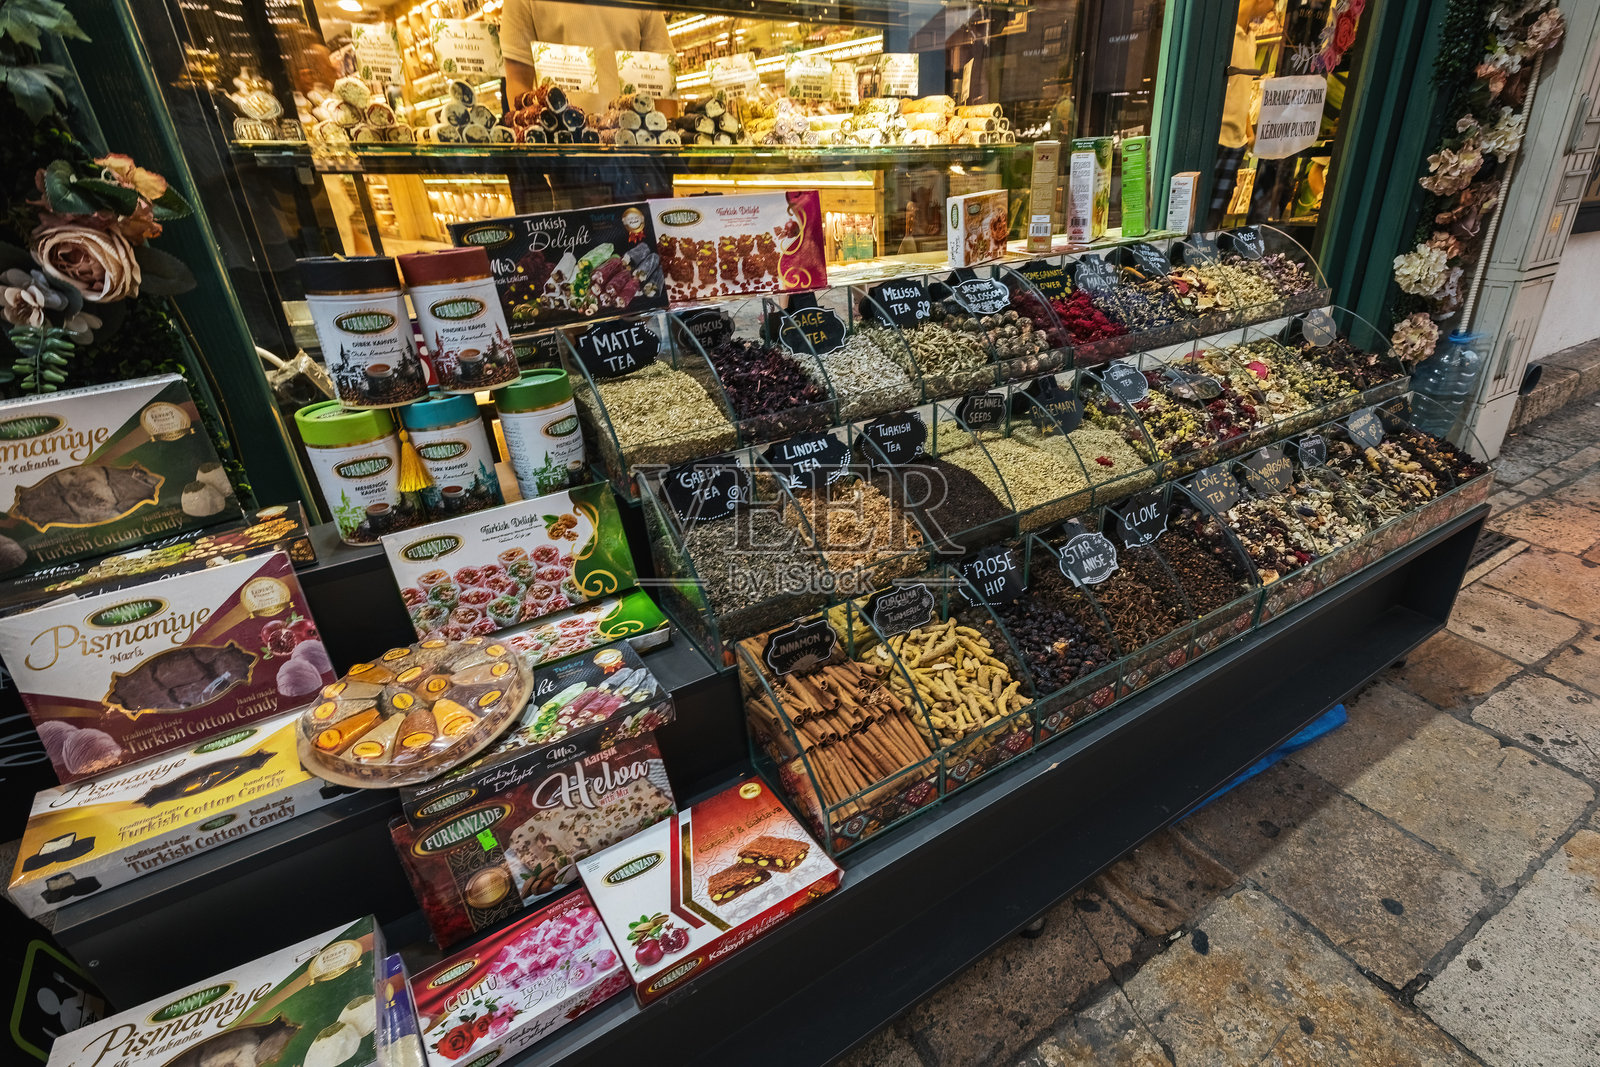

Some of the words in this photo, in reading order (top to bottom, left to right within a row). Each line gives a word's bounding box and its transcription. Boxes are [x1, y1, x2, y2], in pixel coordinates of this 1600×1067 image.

[1264, 89, 1291, 106] BARAME
[1292, 88, 1324, 105] RABOTNIK
[1291, 121, 1316, 138] PUNTOR
[523, 216, 567, 232] Turkish
[468, 230, 509, 244] FURKANZADE
[527, 225, 592, 256] Delight
[1238, 232, 1255, 242] ROSE
[490, 257, 516, 275] Mix
[1081, 263, 1106, 276] BLUE
[961, 282, 994, 295] JASMINE
[966, 288, 1004, 303] BLOSSOM
[435, 301, 483, 317] FURKANZADE
[889, 303, 911, 316] TEA
[341, 314, 394, 332] FURKANZADE
[784, 312, 825, 335] SAGE
[592, 327, 643, 356] MATE
[805, 331, 828, 346] TEA
[603, 352, 636, 372] TEA
[1120, 379, 1133, 388] TEA
[974, 398, 1002, 409] FENNEL
[1031, 400, 1077, 419] ROSEMARY
[967, 411, 992, 424] SEEDS
[875, 422, 911, 437] TURKISH
[420, 444, 465, 457] FURKANZADE
[783, 438, 829, 460] LINDEN
[882, 440, 901, 454] TEA
[8, 457, 60, 475] Kakaolu
[341, 457, 389, 476] FURKANZADE
[793, 454, 822, 474] TEA
[678, 466, 722, 489] GREEN
[1195, 472, 1220, 493] LOVE
[1263, 477, 1281, 490] TEA
[692, 486, 721, 503] TEA
[1207, 491, 1226, 505] TEA
[480, 521, 510, 535] Turkish
[511, 513, 539, 528] Delight
[1124, 502, 1161, 531] CLOVE
[35, 534, 94, 562] Turkish
[93, 526, 142, 548] Cotton
[143, 516, 184, 537] Candy
[407, 538, 458, 558] FURKANZADE
[972, 549, 1017, 577] ROSE
[1063, 544, 1092, 566] STAR
[1081, 551, 1107, 573] ANISE
[983, 576, 1007, 597] HIP
[879, 589, 918, 610] CURCUMA
[885, 604, 922, 623] TURMERIC
[24, 606, 211, 671] Pişmaniye
[771, 633, 821, 658] CINNAMON
[553, 660, 585, 674] Turkey
[127, 728, 186, 756] Turkish
[187, 709, 236, 735] Cotton
[236, 695, 279, 719] Candy
[545, 744, 577, 760] Mix
[477, 765, 518, 785] Turkish
[493, 762, 541, 793] Delight
[532, 761, 649, 809] Helva
[422, 790, 471, 816] FURKANZADE
[616, 787, 629, 799] Mix
[118, 816, 182, 843] Turkish
[185, 794, 236, 820] Cotton
[238, 776, 285, 799] Candy
[424, 807, 502, 851] FURKANZADE
[127, 844, 196, 875] Turkish
[196, 823, 248, 850] Cotton
[249, 804, 296, 829] Candy
[610, 854, 660, 882] FURKANZADE
[708, 938, 745, 961] Kadayıf
[653, 959, 699, 989] FURKANZADE
[443, 973, 500, 1014] GÜLLÜ
[520, 973, 558, 997] Turkish
[82, 982, 273, 1067] Pişmaniye
[504, 1020, 541, 1045] Turkish
[519, 1014, 562, 1047] Delight
